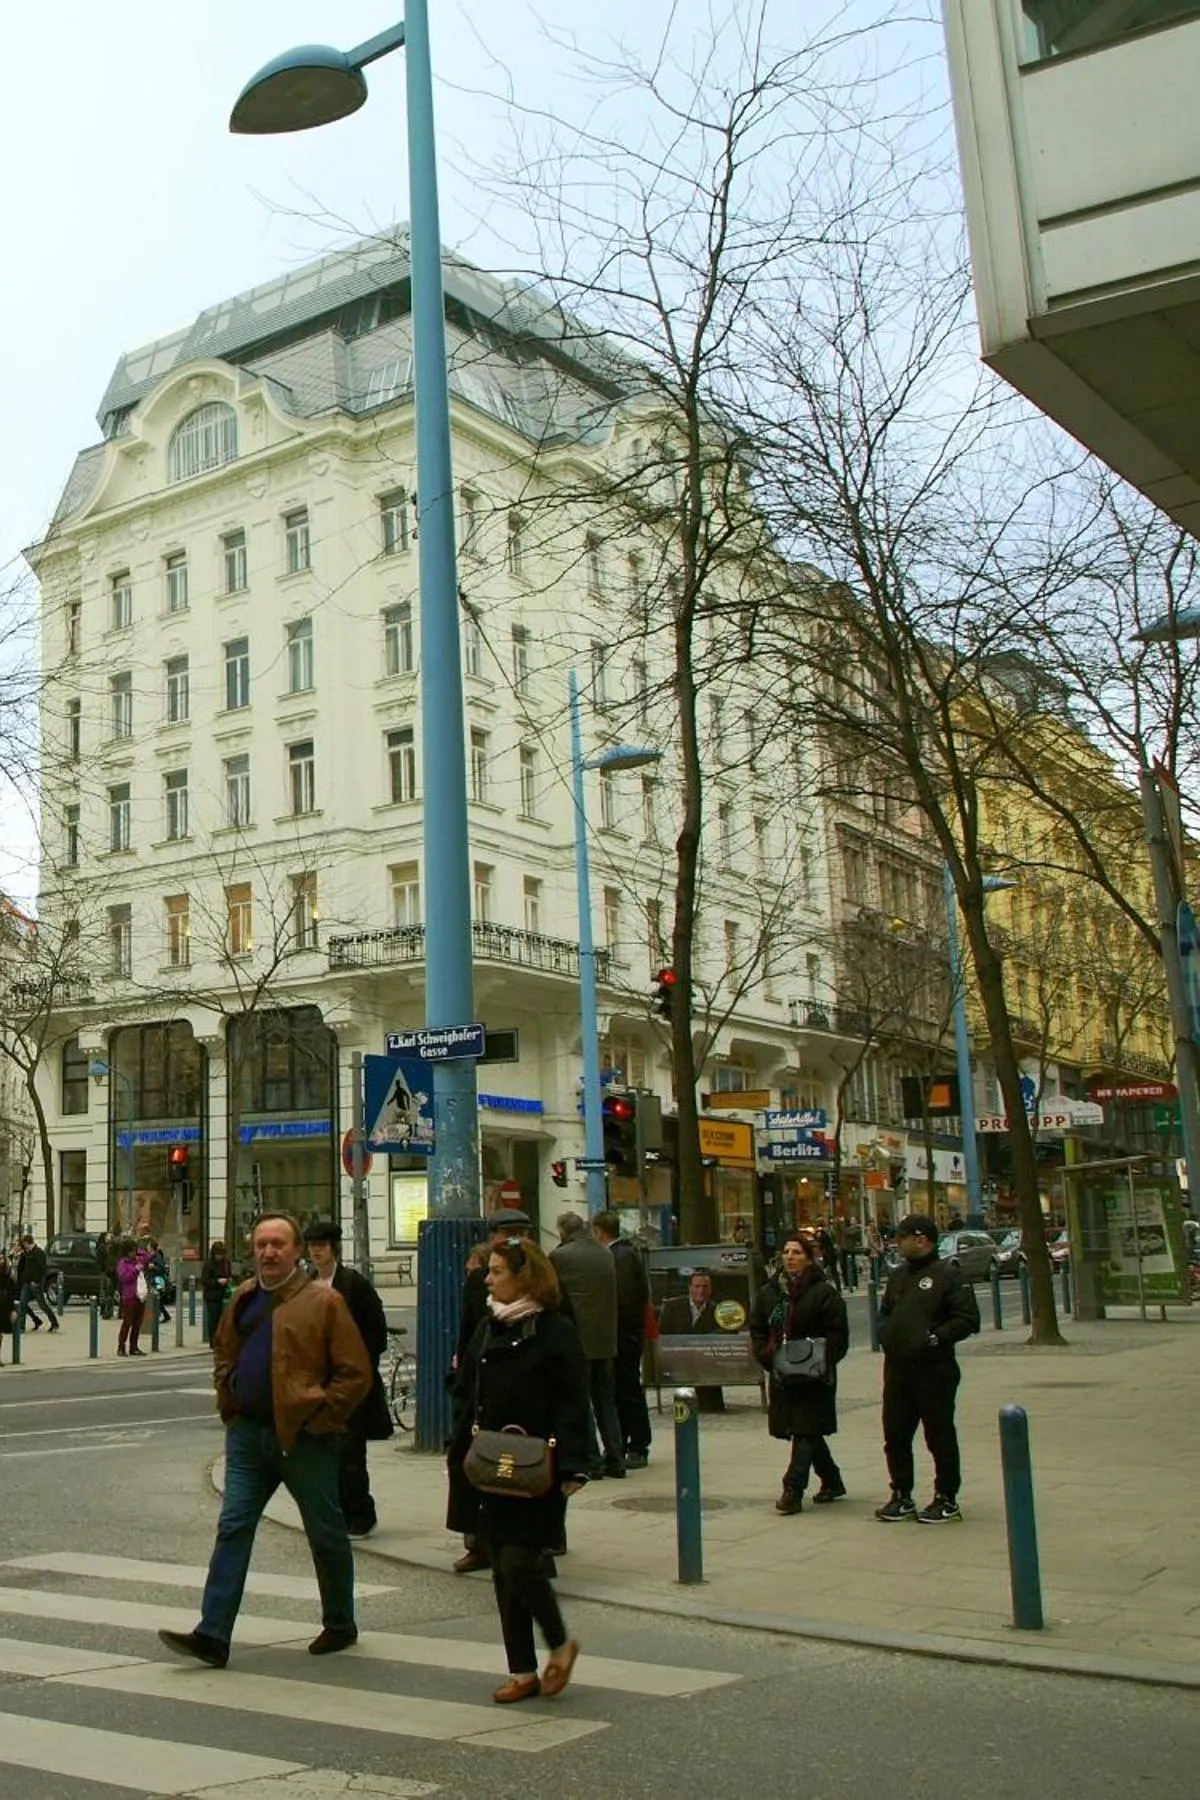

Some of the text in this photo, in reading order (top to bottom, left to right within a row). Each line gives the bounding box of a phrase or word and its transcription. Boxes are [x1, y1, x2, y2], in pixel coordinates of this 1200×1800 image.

[420, 1046, 448, 1058] Gasse
[978, 1114, 1066, 1131] PROOPP
[772, 1143, 821, 1157] Berlitz
